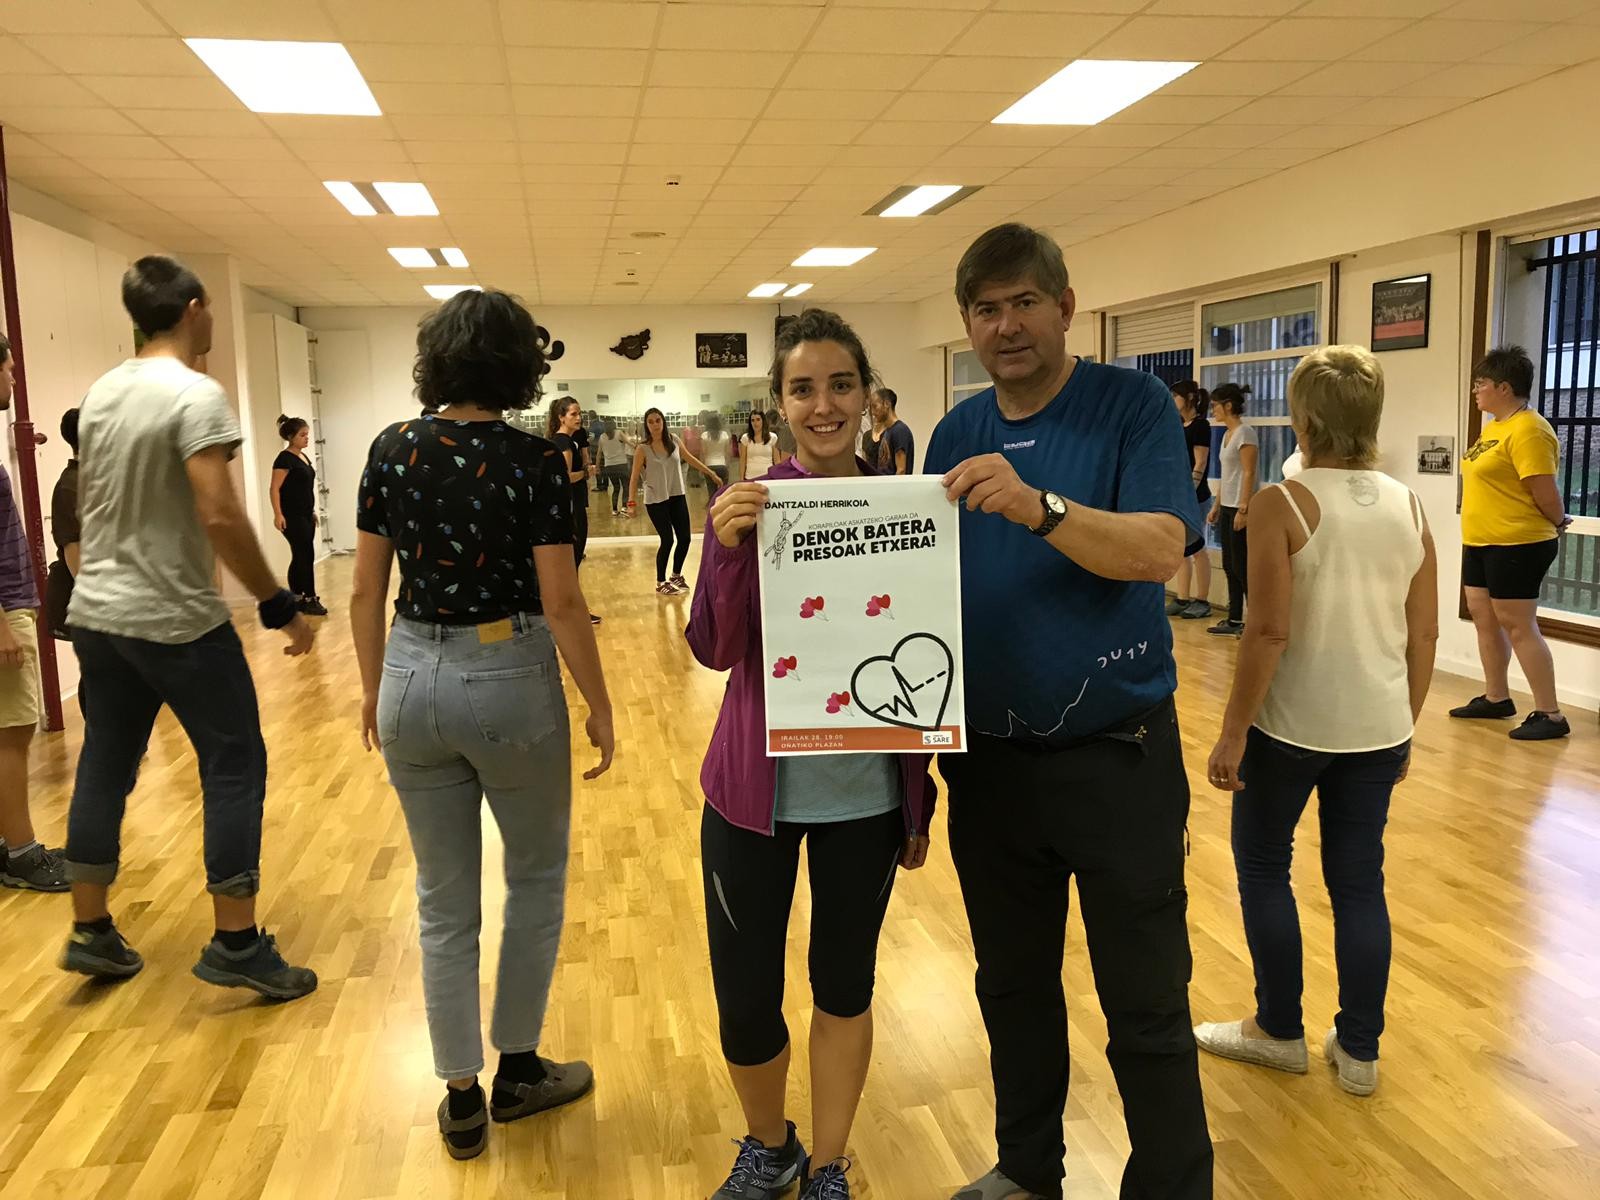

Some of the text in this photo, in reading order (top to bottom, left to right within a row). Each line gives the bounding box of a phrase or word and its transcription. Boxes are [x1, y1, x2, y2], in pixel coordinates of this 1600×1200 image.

[764, 499, 869, 509] DANTZALDI HERRIKOIA
[792, 518, 936, 547] DENOK BATERA
[793, 535, 936, 562] PRESOAK ETXERA!
